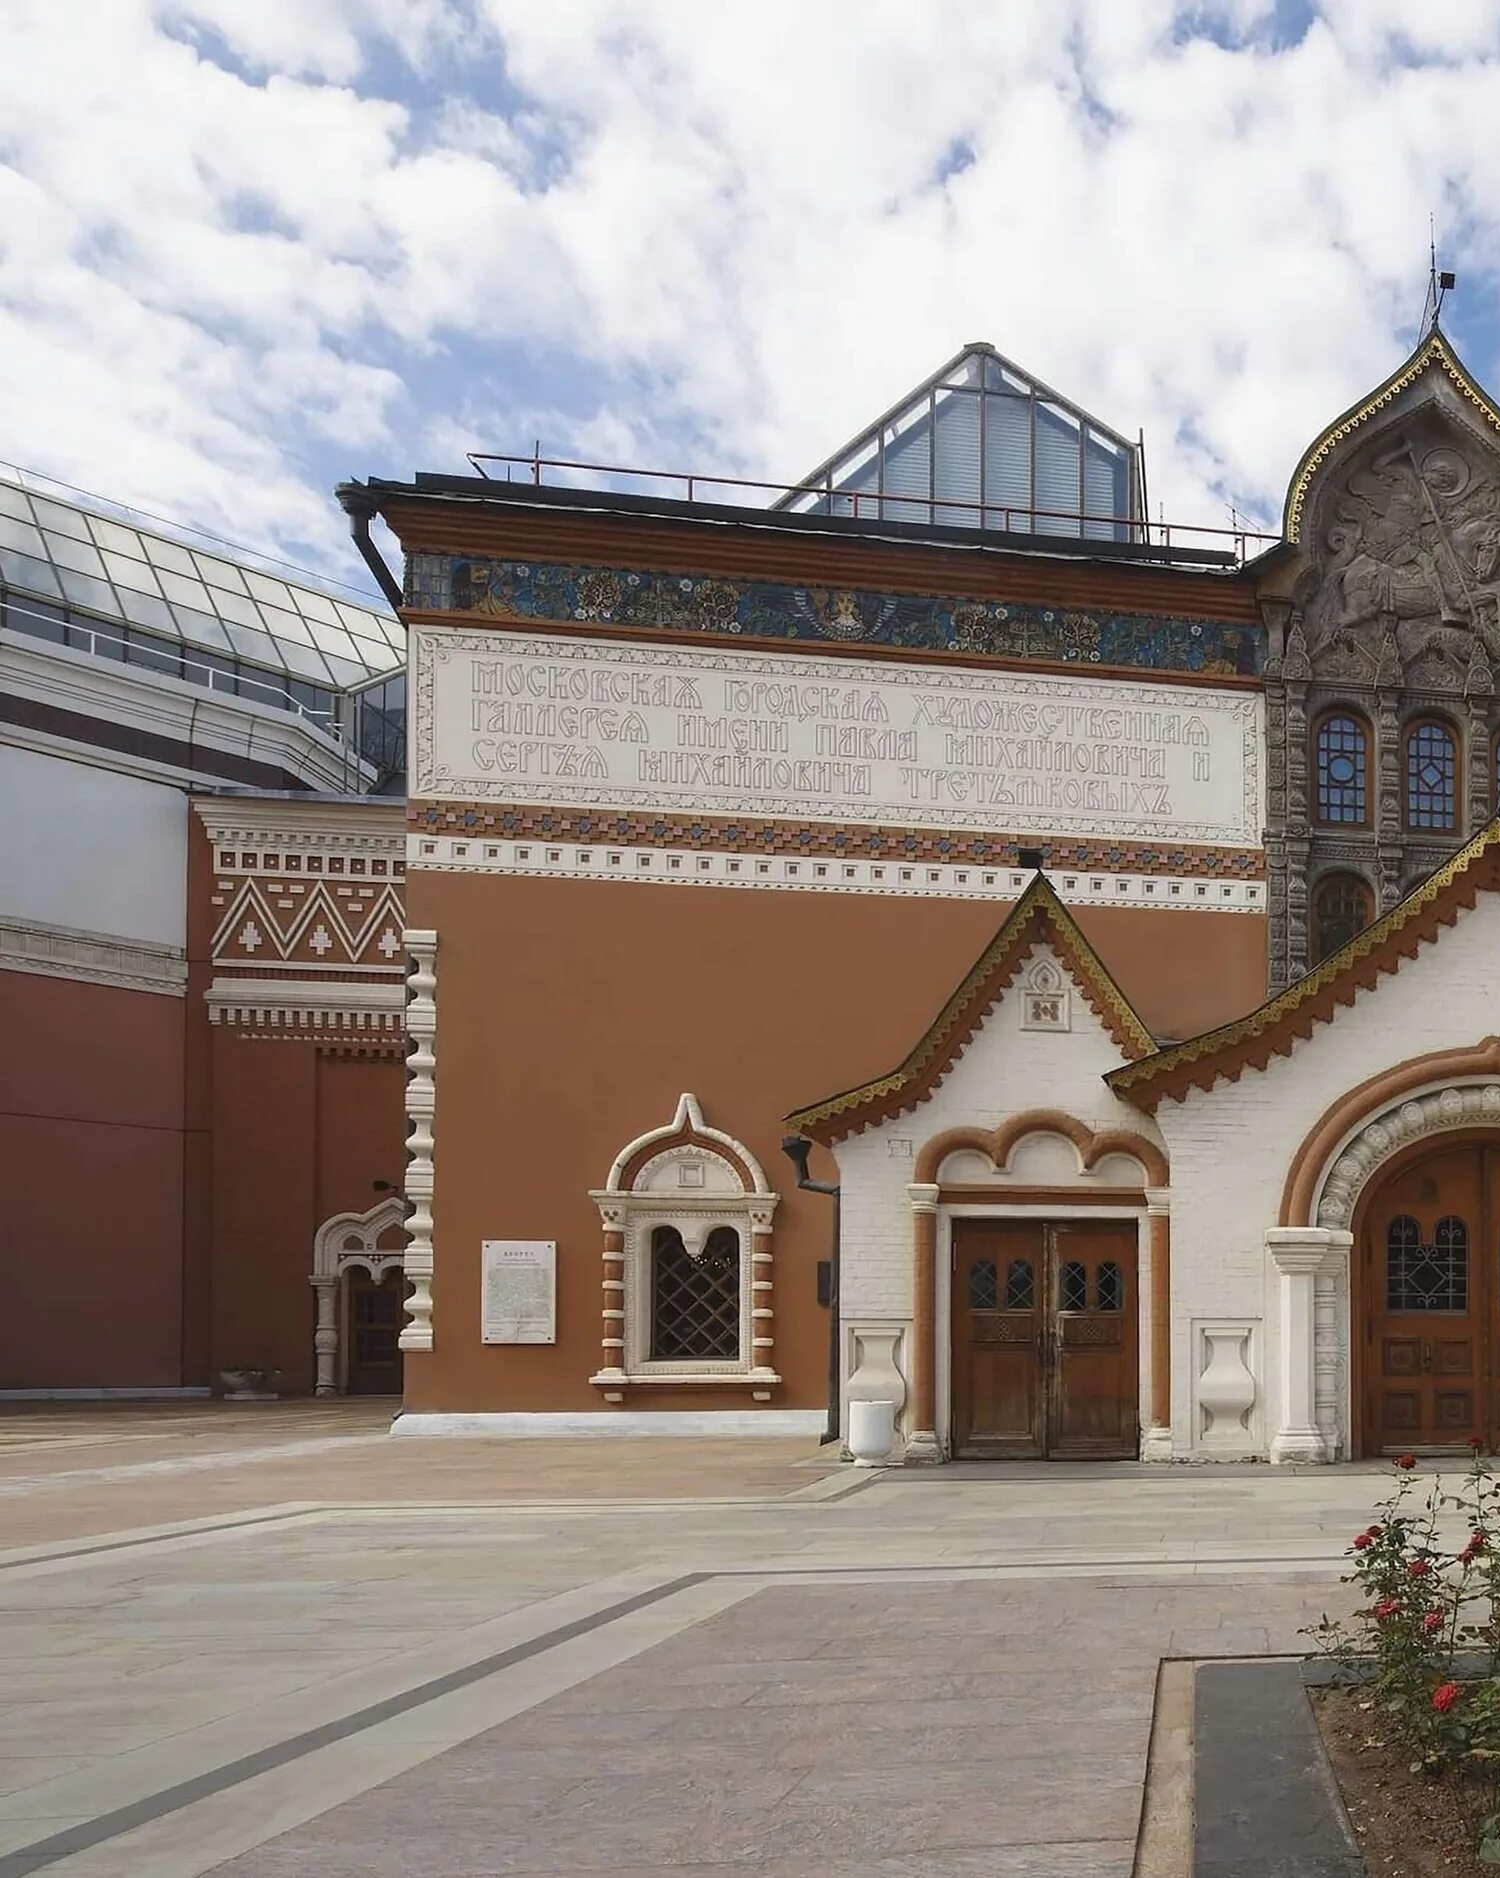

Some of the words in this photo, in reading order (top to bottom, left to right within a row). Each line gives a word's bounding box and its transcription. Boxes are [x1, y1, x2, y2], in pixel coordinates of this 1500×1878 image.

[638, 747, 872, 795] МИХАЙЛОВИЧА
[677, 714, 789, 753] ИМЕНИ
[815, 723, 918, 762] ПАВЛА
[945, 731, 1166, 779] МИХАЙЛОВИЧА
[1193, 751, 1210, 782] И
